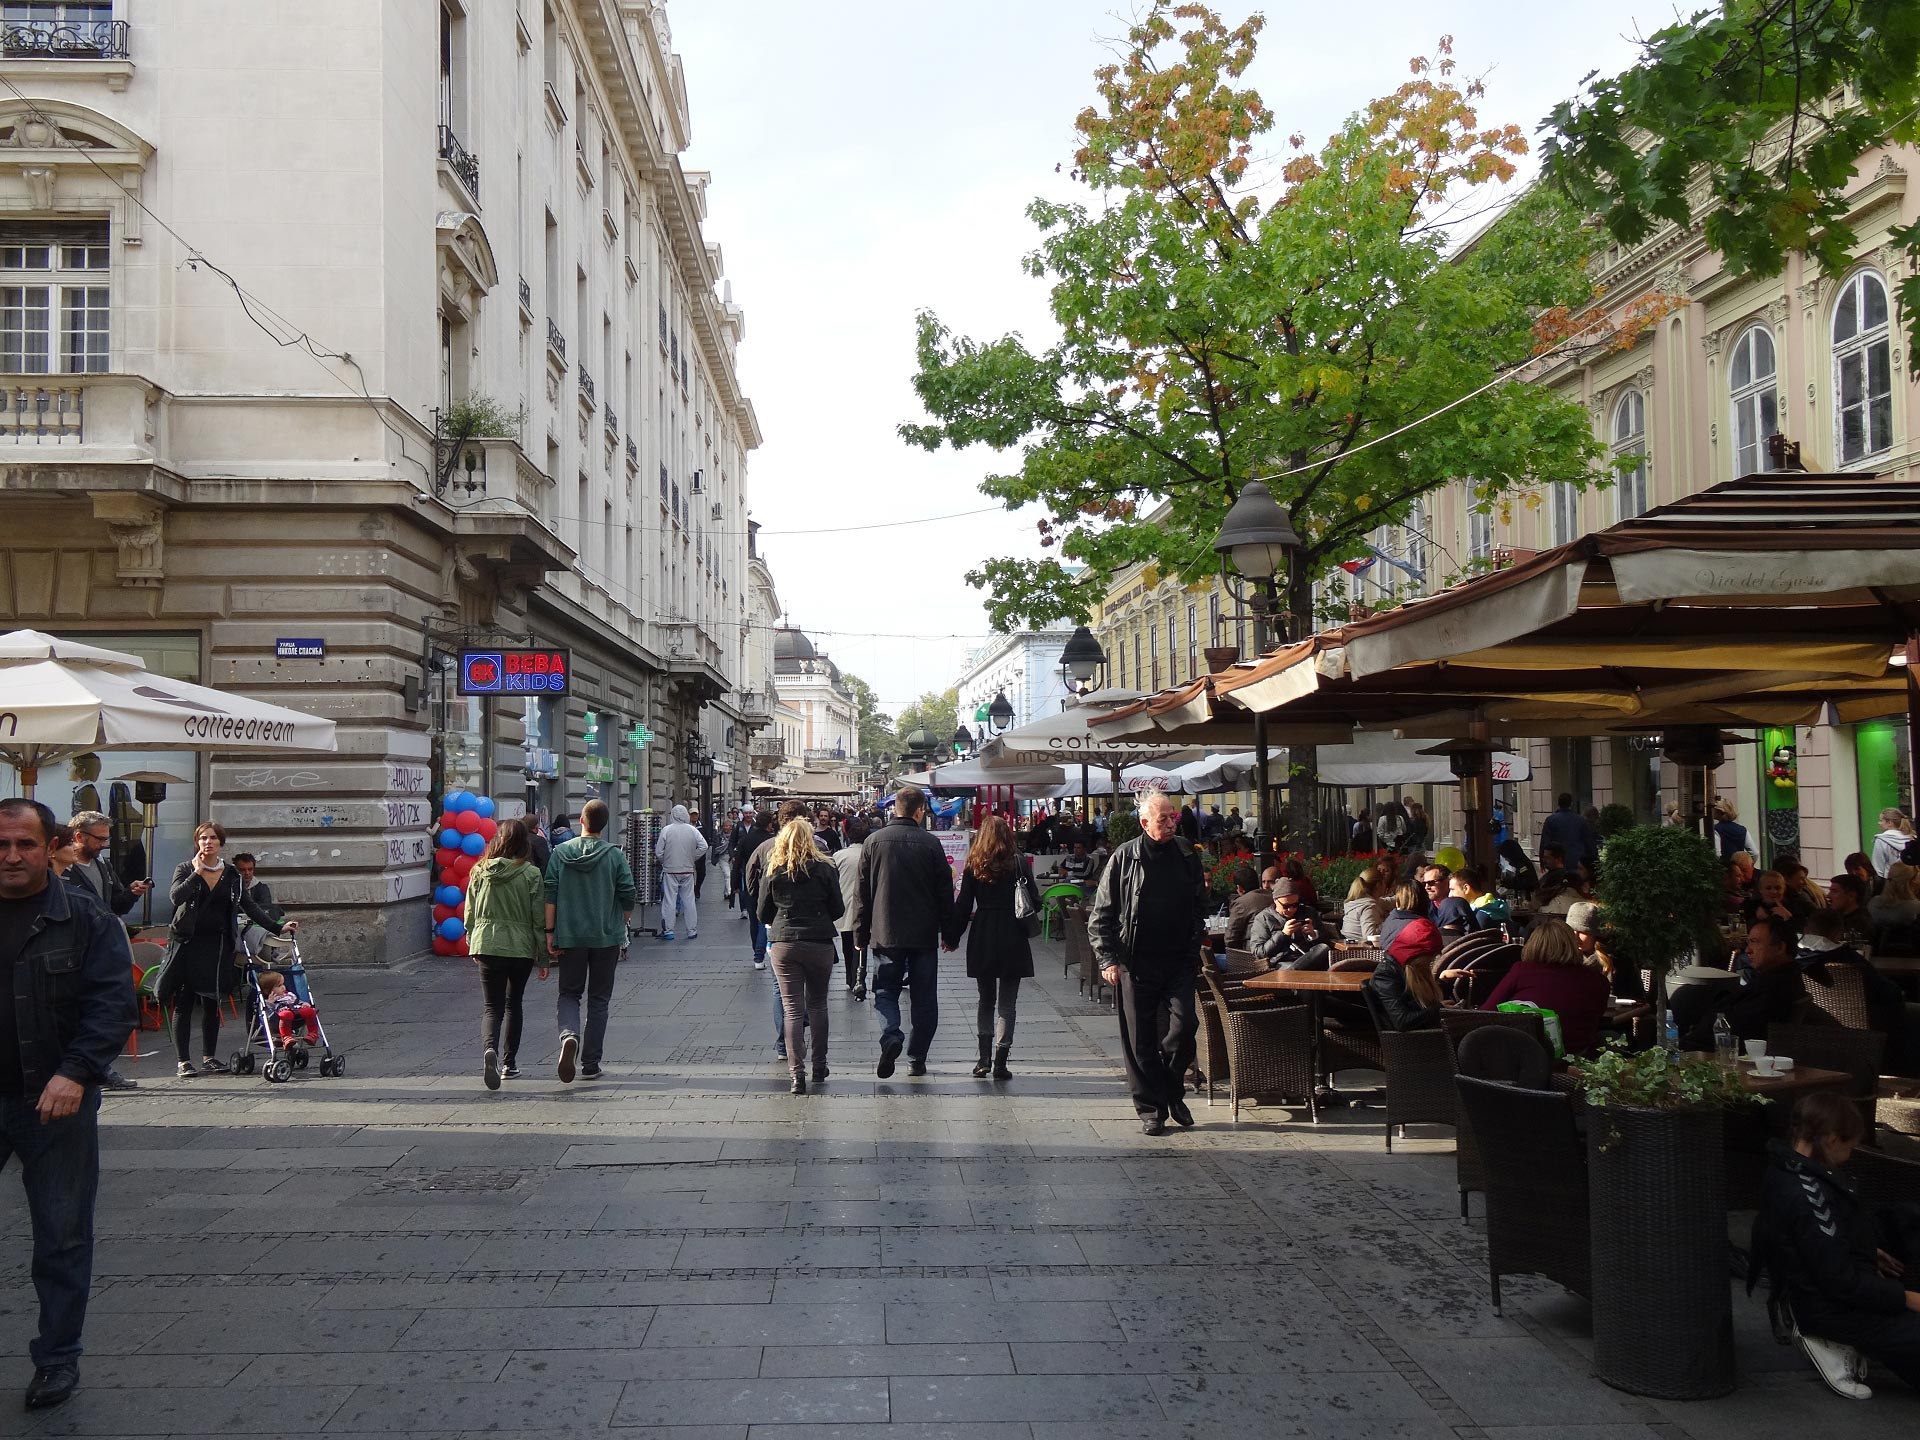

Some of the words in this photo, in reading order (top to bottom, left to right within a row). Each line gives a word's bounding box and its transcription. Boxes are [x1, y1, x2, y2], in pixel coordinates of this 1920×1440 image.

[277, 647, 298, 655] НИКОЛЕ
[471, 664, 495, 681] BK
[505, 654, 565, 674] BEBA
[505, 673, 565, 691] KIDS
